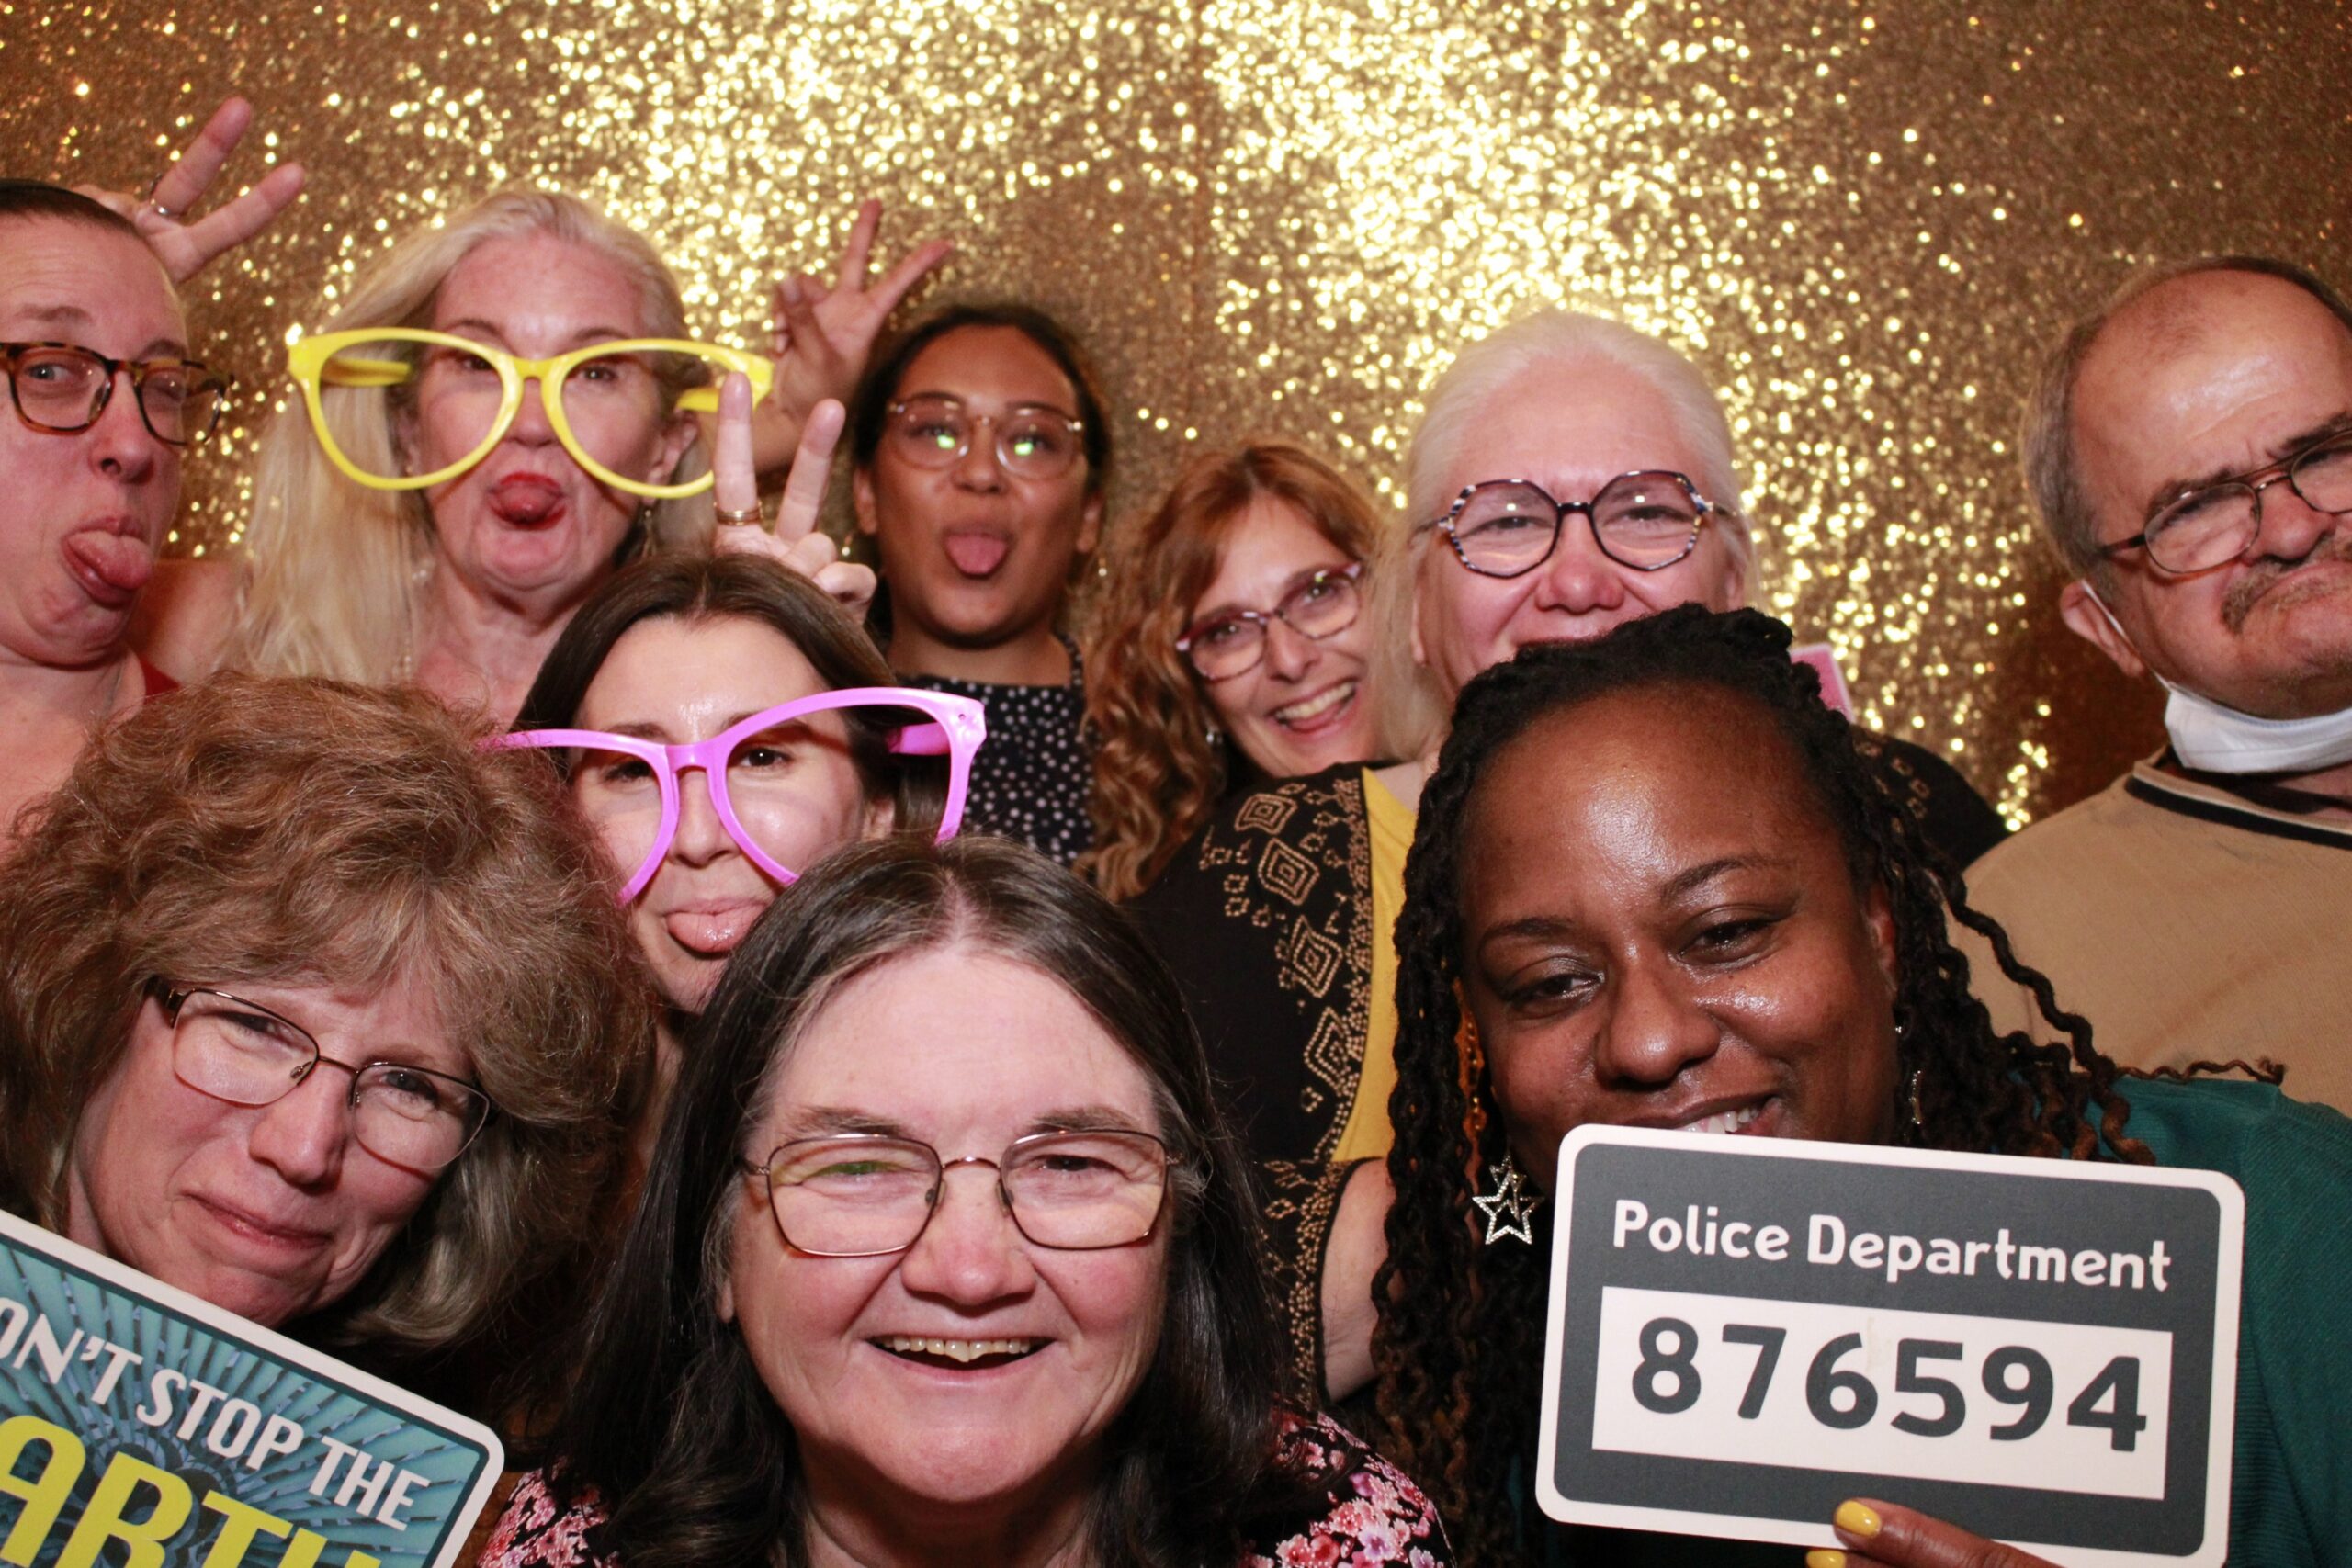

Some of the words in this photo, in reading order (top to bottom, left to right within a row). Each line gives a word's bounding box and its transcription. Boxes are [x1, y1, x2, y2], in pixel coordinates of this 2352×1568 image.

[1612, 1199, 1790, 1262] Police
[1807, 1213, 2171, 1292] Department
[136, 1368, 304, 1471] STOP
[309, 1435, 432, 1532] THE
[1631, 1316, 2148, 1453] 876594
[0, 1415, 382, 1568] ART
